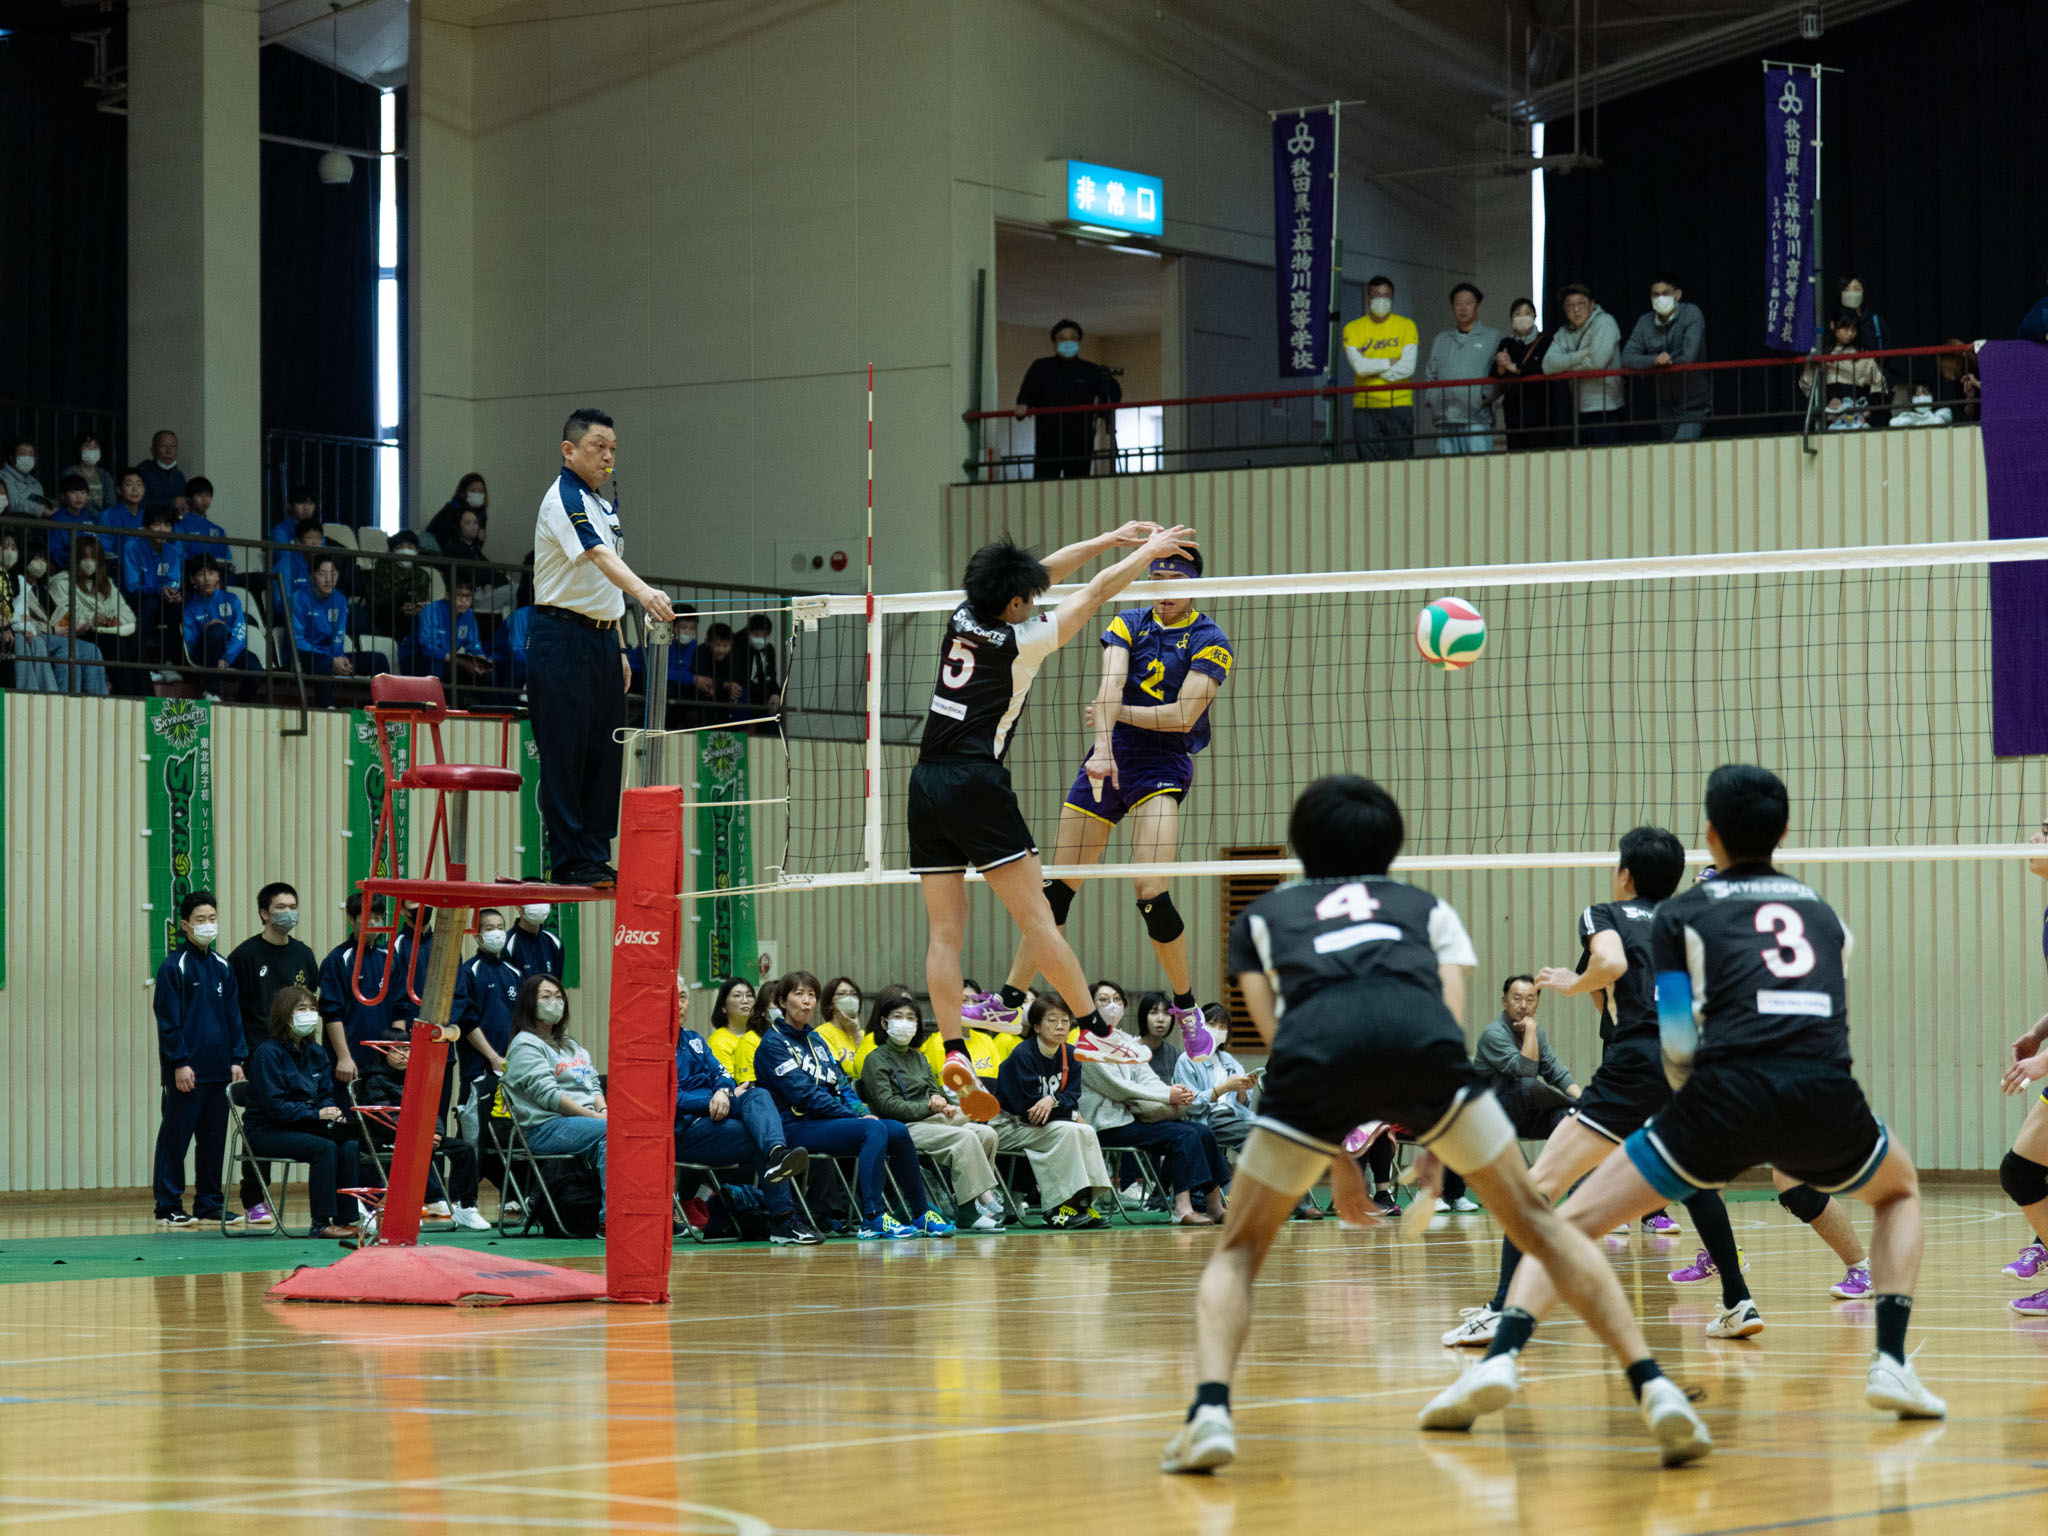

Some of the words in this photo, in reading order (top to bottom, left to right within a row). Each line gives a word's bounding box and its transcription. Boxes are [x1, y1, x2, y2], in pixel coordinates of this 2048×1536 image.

[1076, 175, 1155, 222] 非常口
[1290, 157, 1316, 369] 秋田県立雄物川高等学校
[942, 636, 978, 689] 5
[1213, 648, 1228, 664] 秋田
[1140, 658, 1165, 701] 2
[153, 708, 206, 734] SKYROCKETS
[200, 737, 209, 801] 東北男子初
[202, 807, 210, 892] Vリーグ参入へ
[1315, 882, 1381, 921] 4
[168, 924, 177, 951] AKI
[624, 929, 661, 946] asics
[1754, 902, 1815, 978] 3
